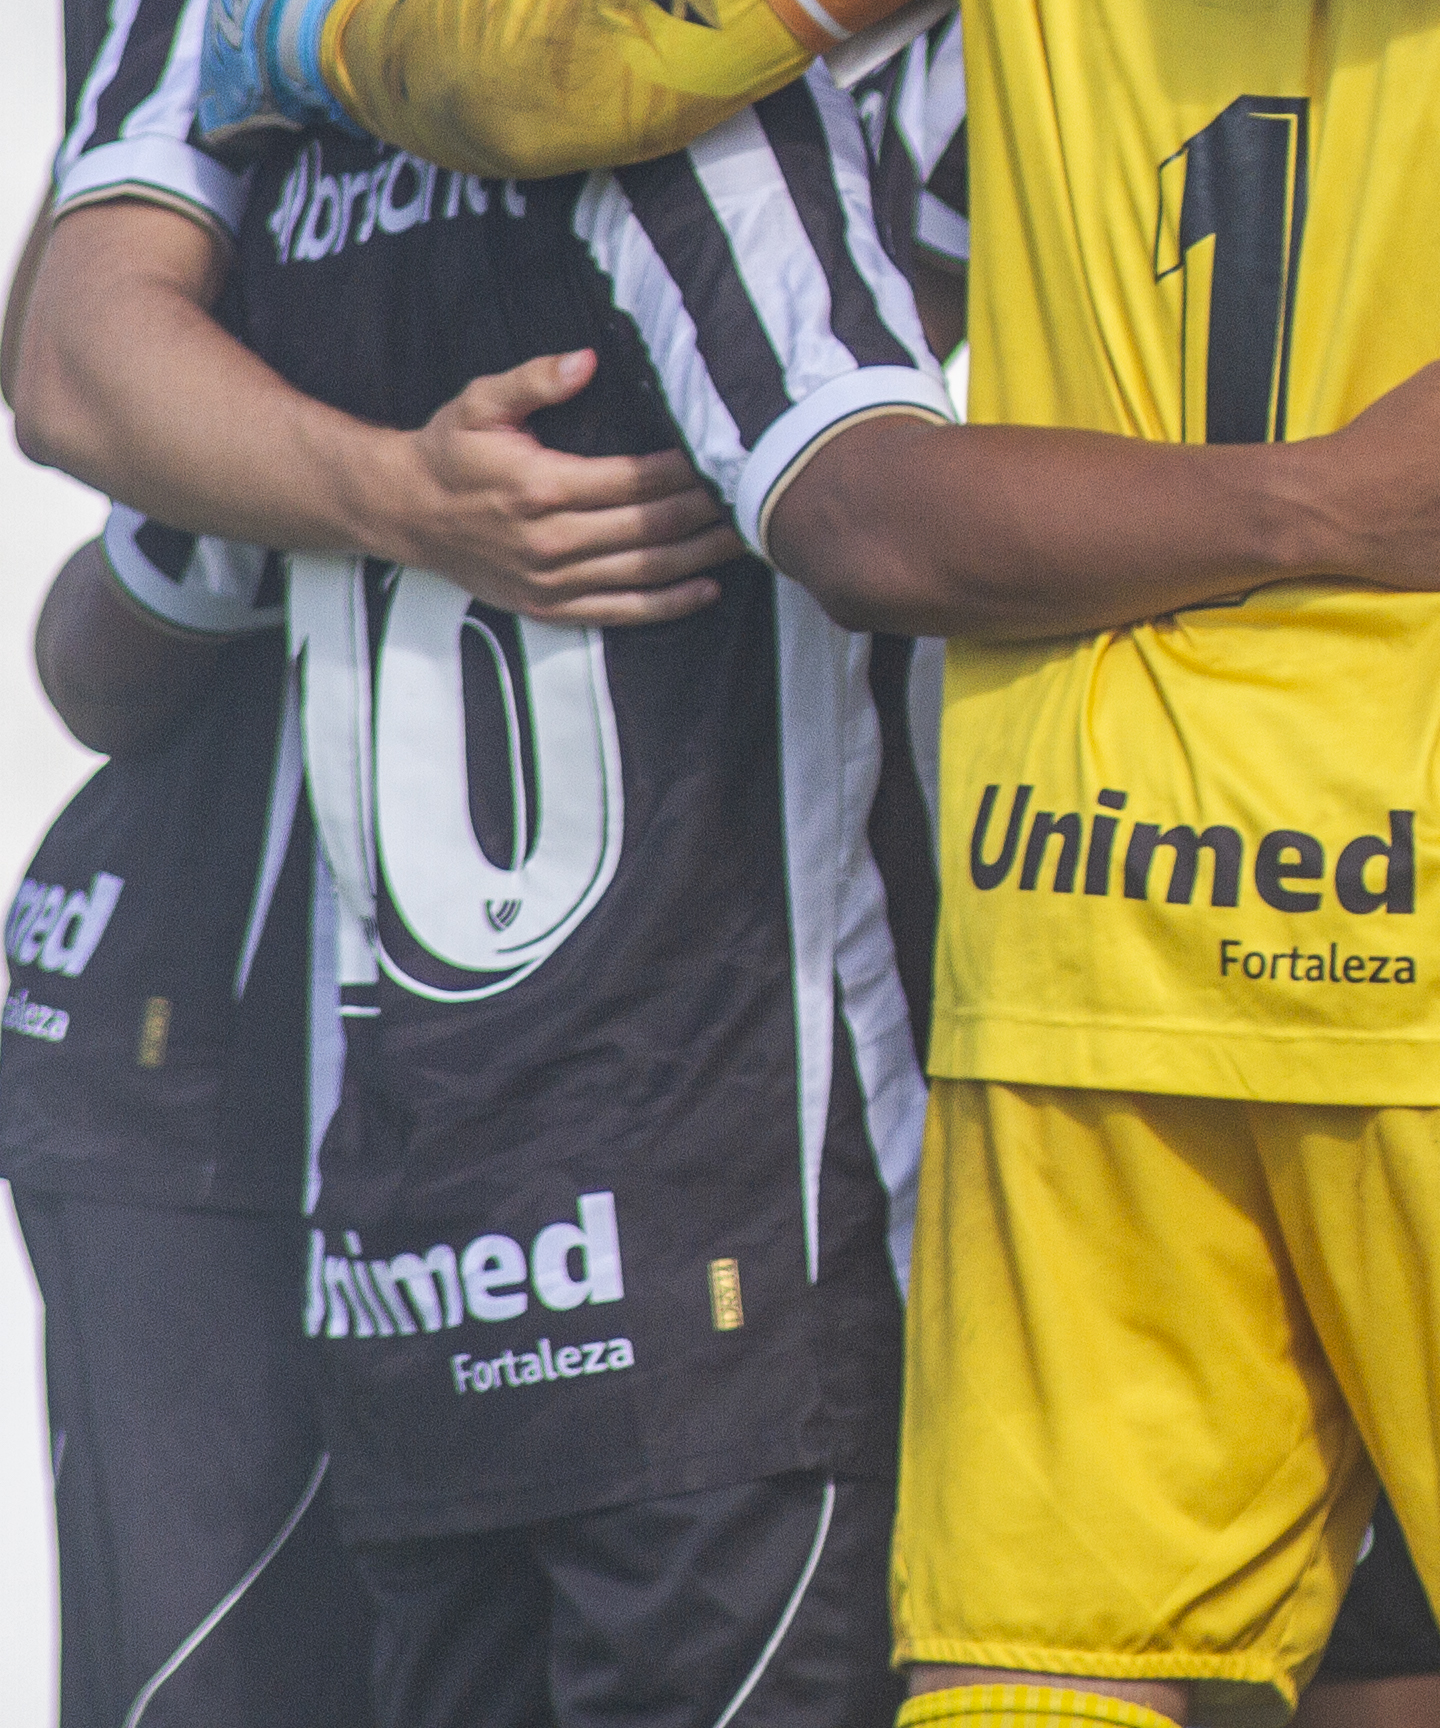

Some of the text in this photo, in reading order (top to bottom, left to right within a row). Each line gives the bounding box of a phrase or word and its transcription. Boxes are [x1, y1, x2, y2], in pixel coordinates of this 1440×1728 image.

[1155, 95, 1310, 444] 1
[968, 782, 1417, 916] Unimed
[1219, 938, 1417, 985] Fortaleza
[451, 1337, 636, 1394] Fortaleza
